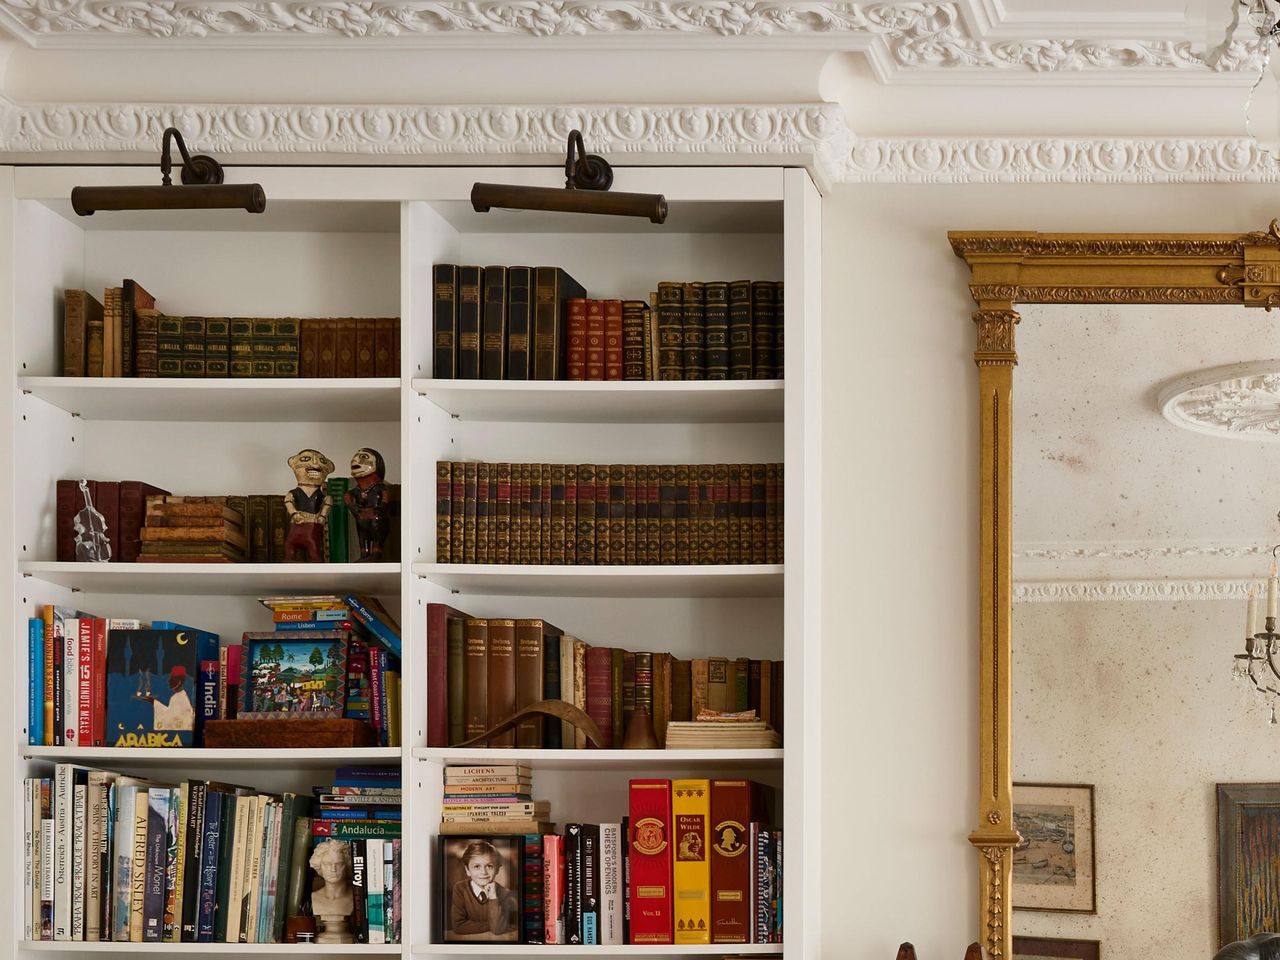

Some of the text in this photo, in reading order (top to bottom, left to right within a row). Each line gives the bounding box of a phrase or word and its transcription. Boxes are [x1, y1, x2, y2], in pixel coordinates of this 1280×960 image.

[825, 341, 835, 385] Andalucía
[360, 607, 374, 622] Rome
[66, 638, 74, 657] food
[80, 622, 91, 662] JAMIE'S
[80, 681, 90, 709] MINUTE
[204, 681, 217, 717] India
[80, 711, 90, 734] MEALS
[58, 767, 66, 800] Autriche
[57, 844, 65, 884] Österreich
[91, 838, 99, 871] HISTORY
[133, 815, 147, 916] ALFRED SISLEY
[91, 873, 98, 882] IN
[153, 865, 164, 895] Monet
[352, 856, 364, 887] Ellroy
